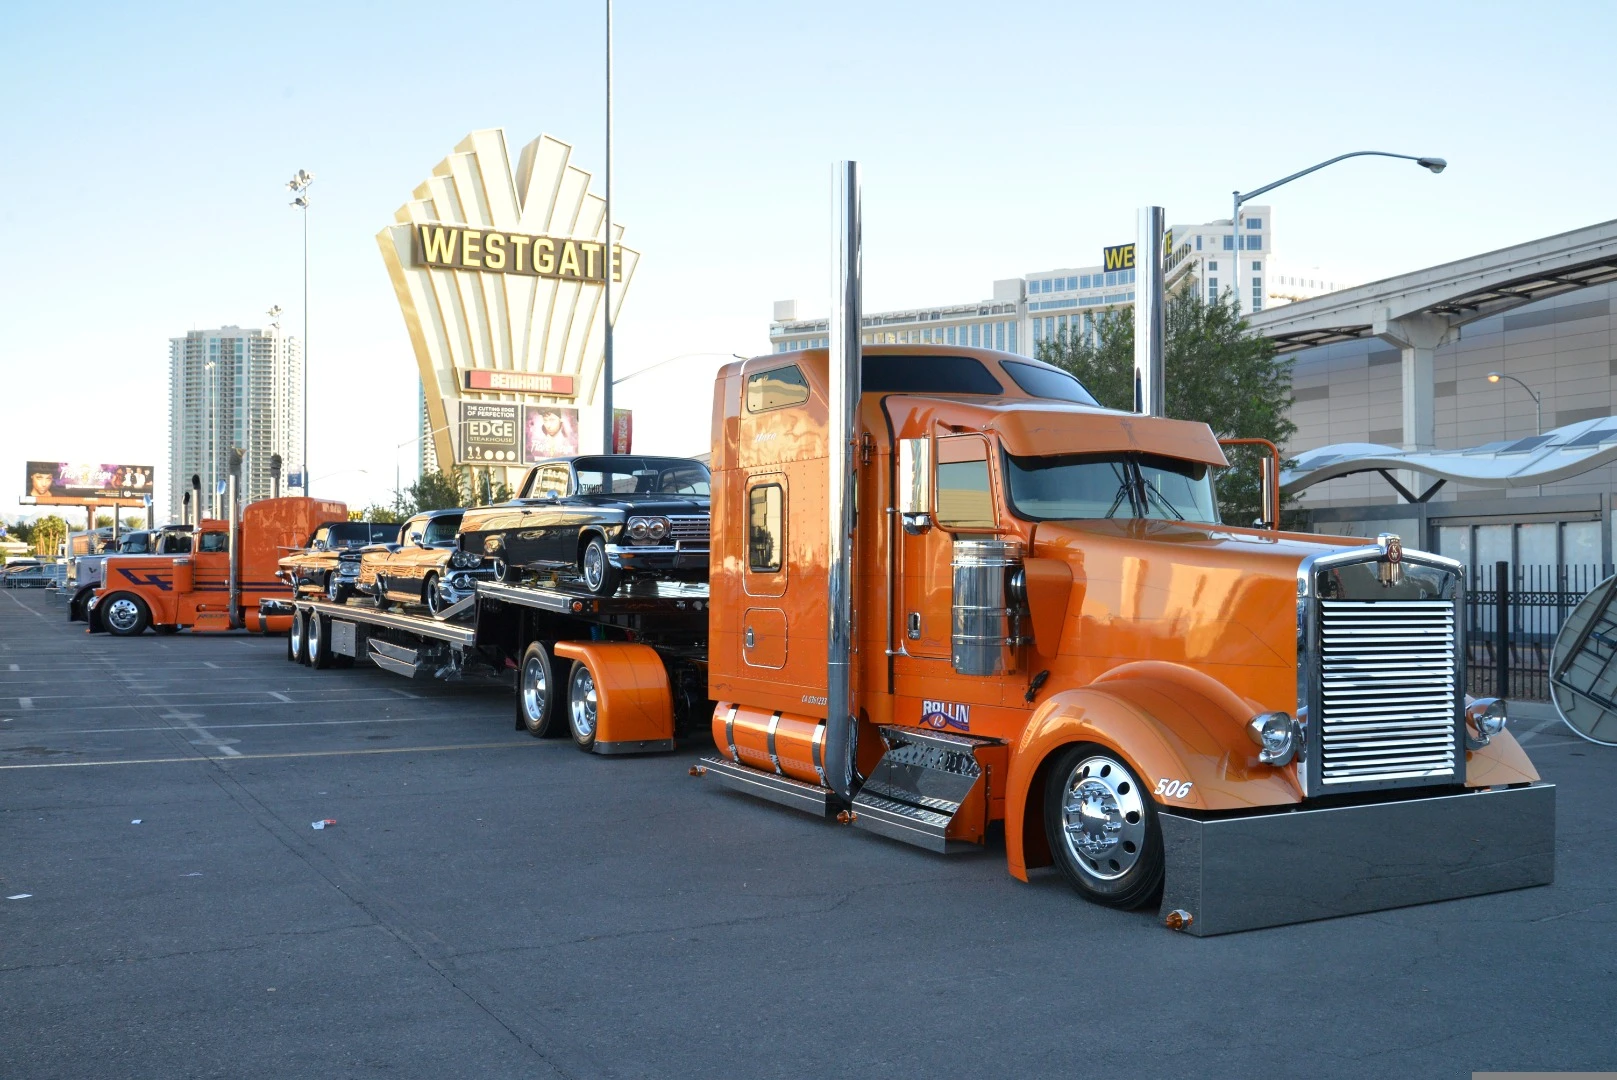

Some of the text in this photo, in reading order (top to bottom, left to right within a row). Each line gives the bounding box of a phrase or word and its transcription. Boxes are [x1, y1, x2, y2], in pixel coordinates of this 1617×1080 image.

[421, 226, 621, 281] WESTGATE
[469, 421, 513, 437] EDGE
[923, 700, 970, 723] ROLLIN
[1154, 778, 1193, 799] 506
